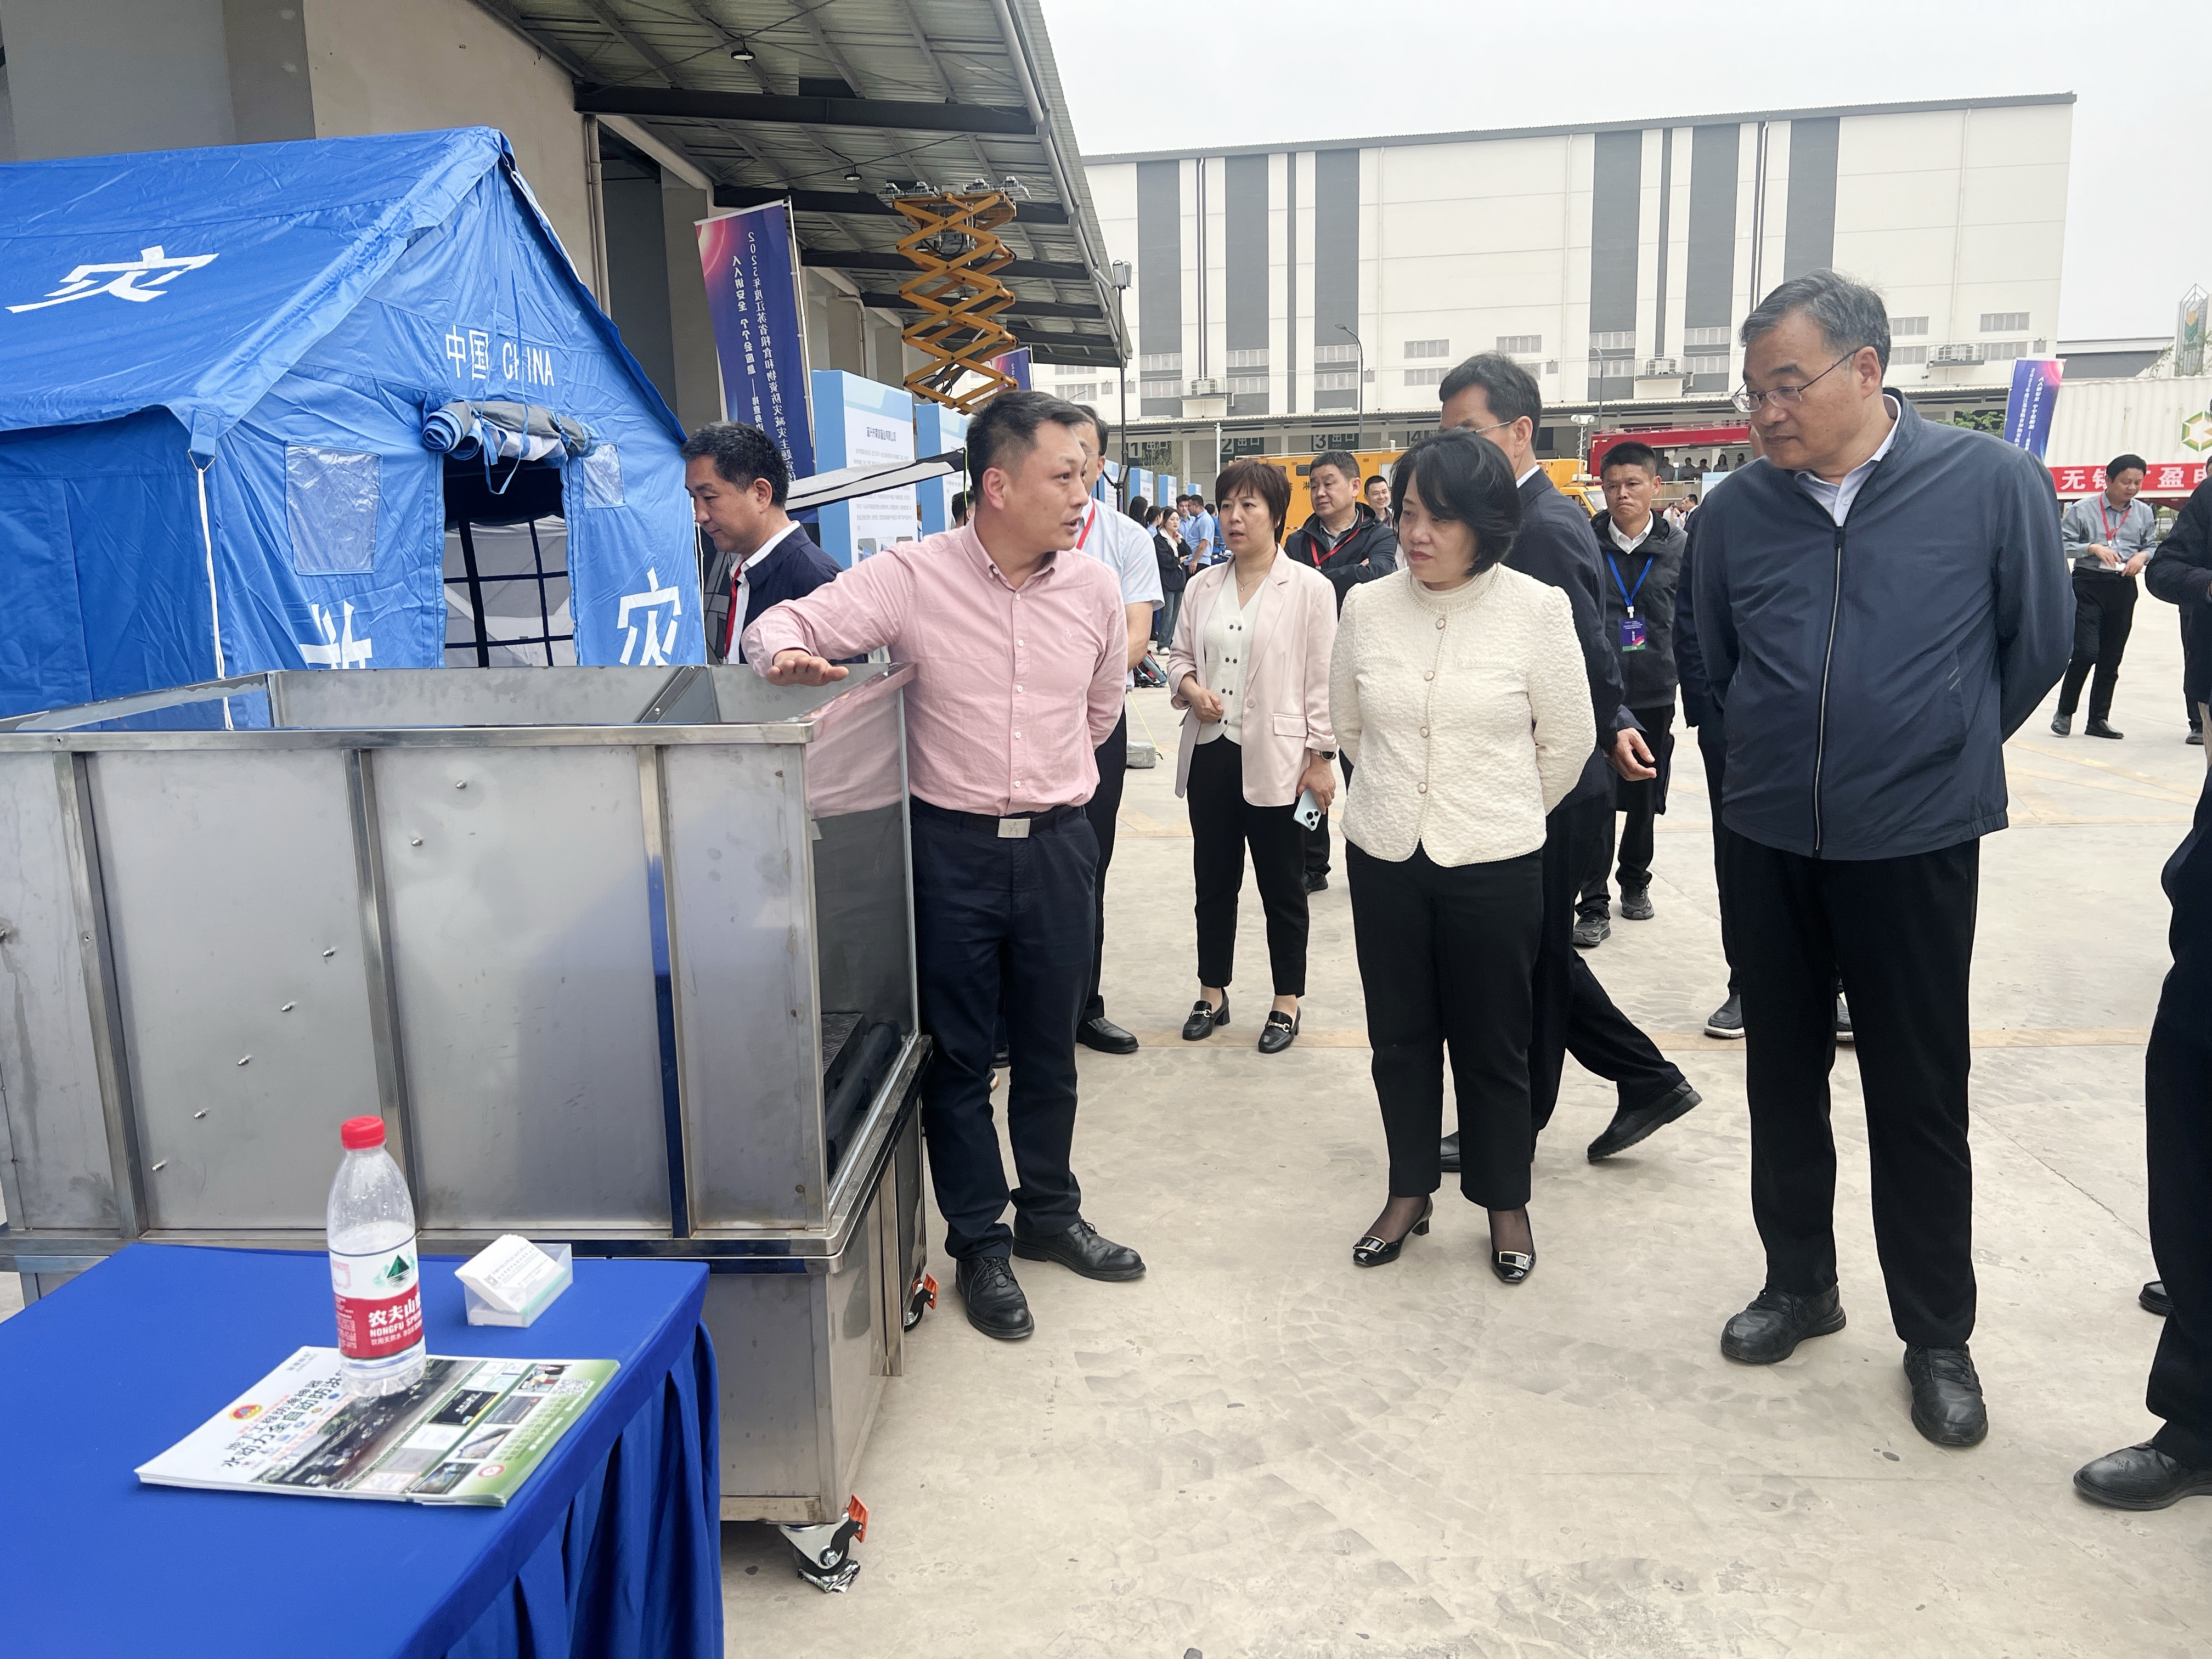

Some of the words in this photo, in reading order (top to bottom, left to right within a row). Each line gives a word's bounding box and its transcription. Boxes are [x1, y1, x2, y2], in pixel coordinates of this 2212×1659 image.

[5, 245, 219, 313] 灾
[445, 324, 489, 380] 中国
[1130, 442, 1138, 456] 1
[1221, 438, 1232, 453] 2
[1238, 438, 1260, 446] 出口
[1316, 435, 1326, 448] 3
[1332, 433, 1355, 442] 出口
[2061, 467, 2207, 490] 无锡盈
[617, 566, 682, 665] 灾
[370, 1321, 404, 1337] NONGFU
[221, 1369, 342, 1467] 水动力全自动防洪
